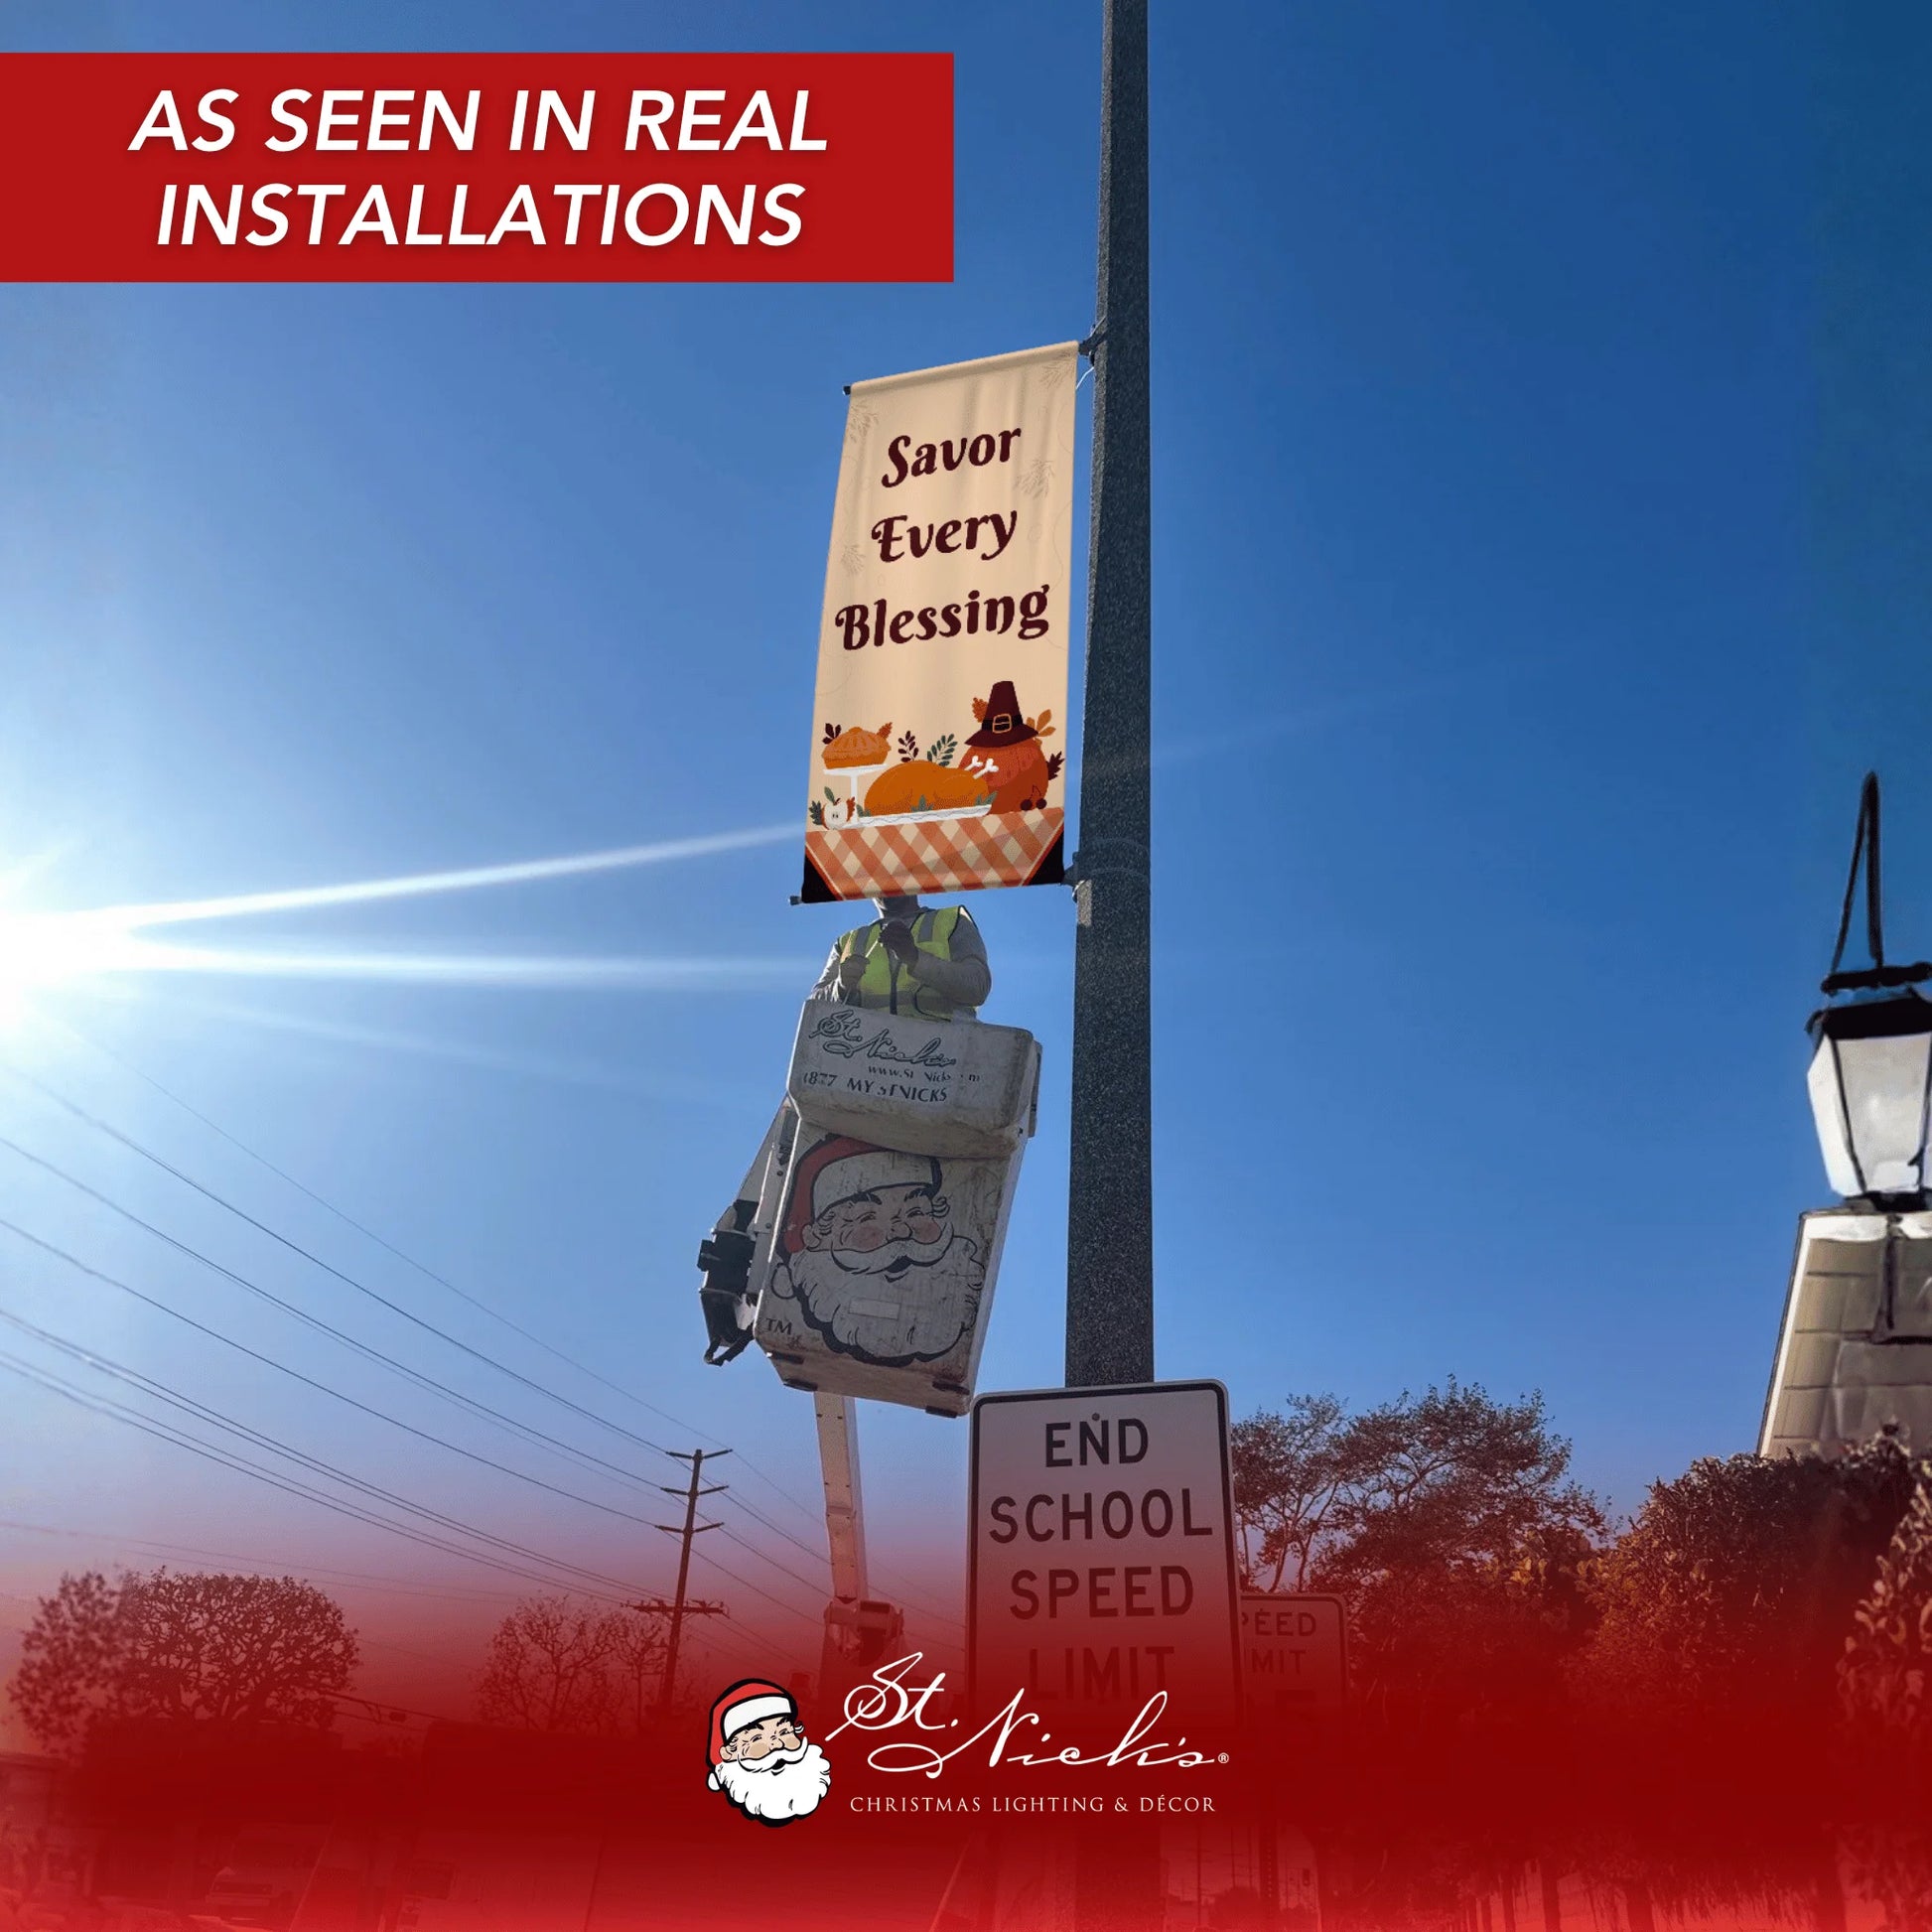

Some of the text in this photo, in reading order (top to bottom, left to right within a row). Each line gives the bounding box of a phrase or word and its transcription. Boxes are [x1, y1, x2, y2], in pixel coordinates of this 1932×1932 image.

[881, 427, 1022, 488] Savor
[871, 509, 1018, 563] Every
[834, 584, 1050, 650] Blessing
[847, 1077, 875, 1093] MY
[765, 1317, 792, 1335] TM
[1045, 1418, 1149, 1467] END
[989, 1488, 1213, 1544] SCHOOL
[1009, 1566, 1194, 1620] SPEED
[1029, 1646, 1175, 1702] LIMIT
